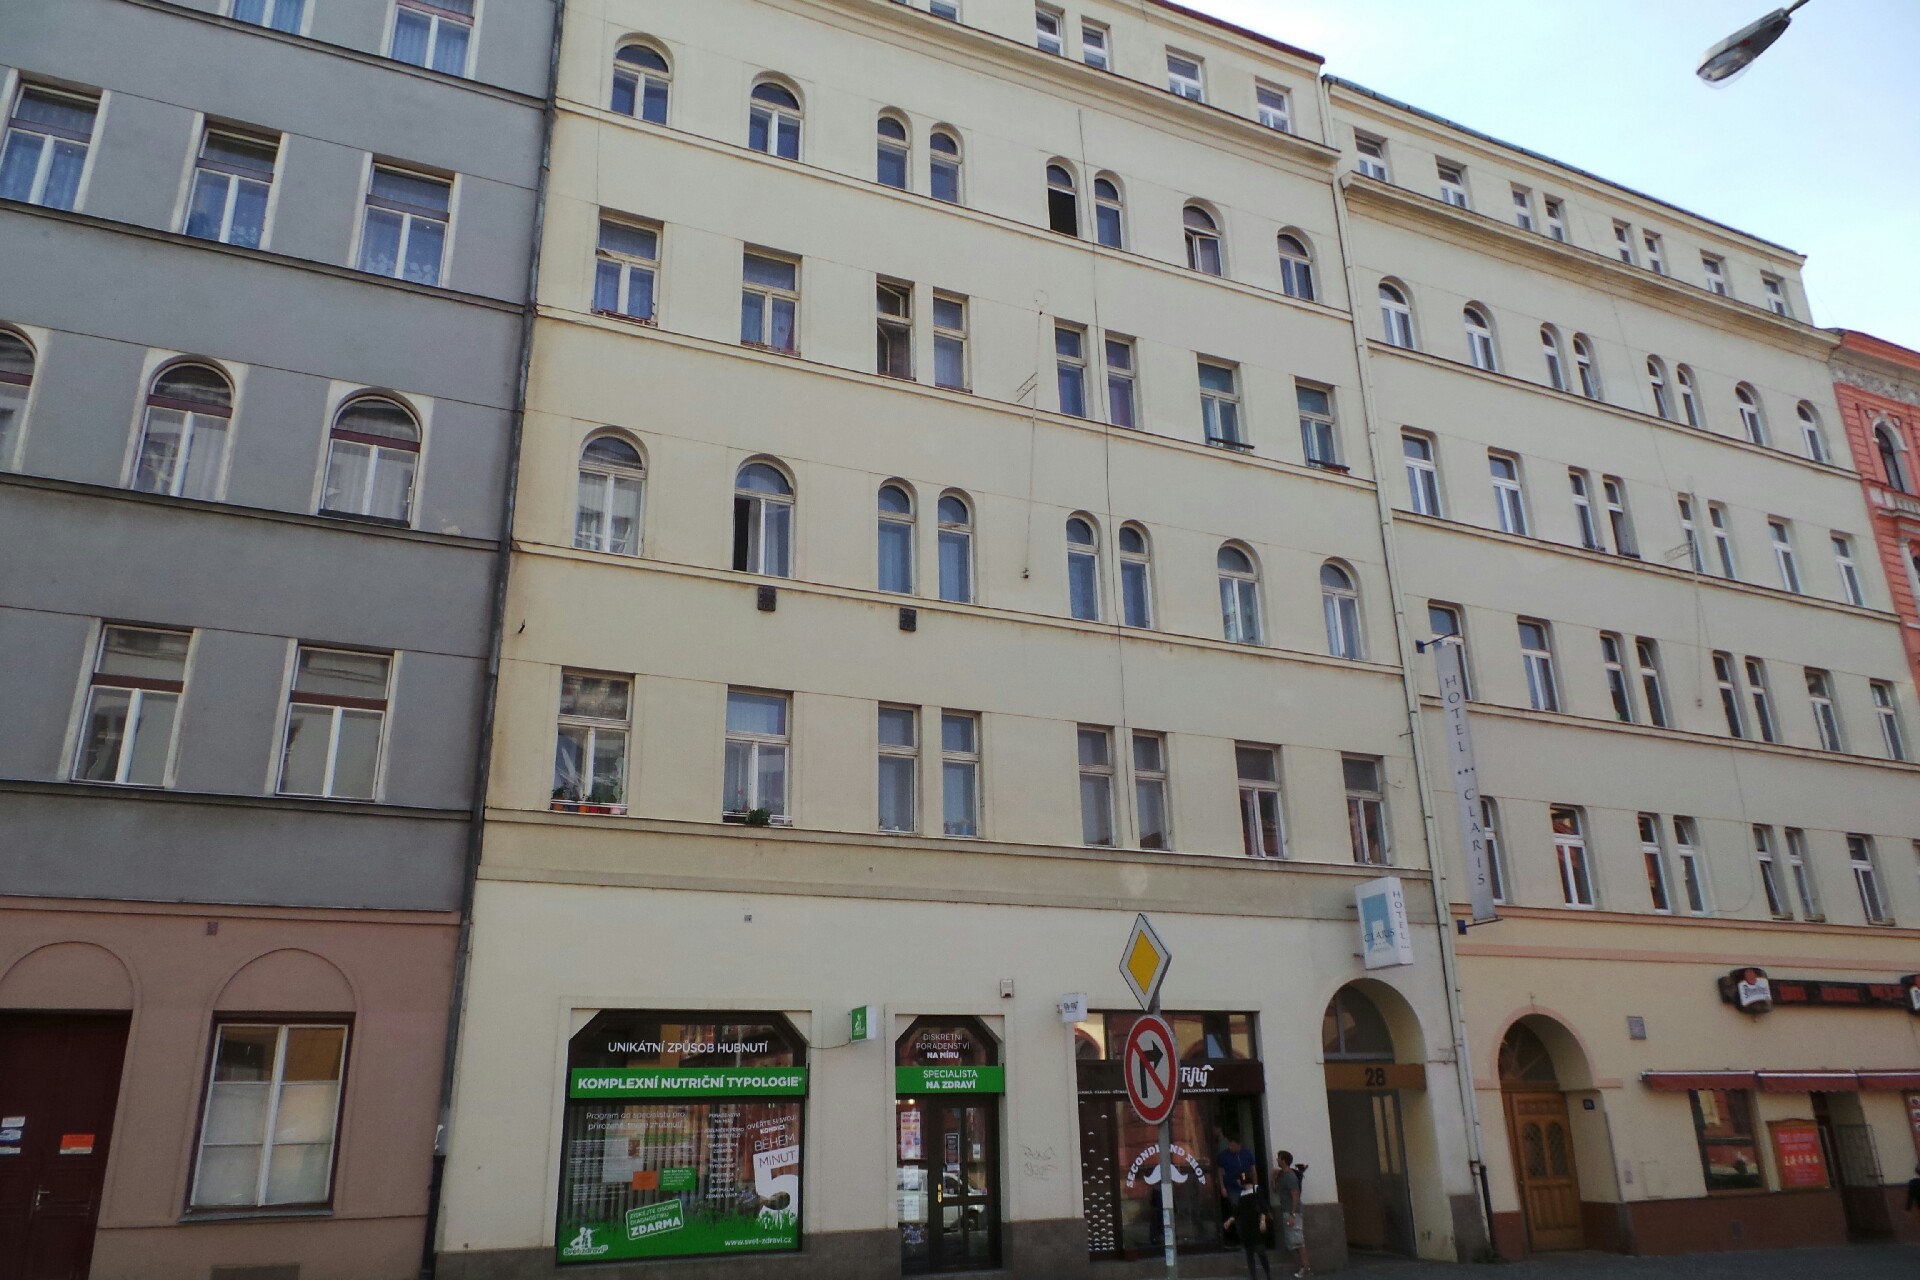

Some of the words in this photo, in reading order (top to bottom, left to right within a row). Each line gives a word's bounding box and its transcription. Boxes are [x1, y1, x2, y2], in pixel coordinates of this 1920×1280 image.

[1445, 675, 1464, 752] HOTEL
[1464, 787, 1486, 886] CLARIS
[1392, 891, 1405, 940] HOTEL
[1364, 928, 1395, 943] CLARIS
[608, 1040, 665, 1054] UNIKÁTNÍ
[667, 1040, 715, 1053] ZPŮSOB
[717, 1040, 768, 1053] HUBNUTÍ
[916, 1042, 970, 1050] PORADENSTVÍ
[927, 1051, 939, 1059] NA
[939, 1050, 960, 1059] MÍRU
[577, 1075, 659, 1090] KOMPLEXNÍ
[660, 1073, 724, 1089] NUTRIČNÍ
[923, 1069, 978, 1079] SPECIALISTA
[1180, 1066, 1208, 1088] Fifty
[1364, 1067, 1386, 1087] 28
[926, 1080, 940, 1089] NA
[941, 1079, 976, 1089] ZDRAVÍ
[586, 1111, 619, 1120] Program
[754, 1132, 796, 1152] BĚHEM
[759, 1149, 796, 1168] MINUT
[1126, 1144, 1185, 1188] SECONDND
[1185, 1153, 1206, 1185] SHOP
[630, 1216, 681, 1237] ZDARMA
